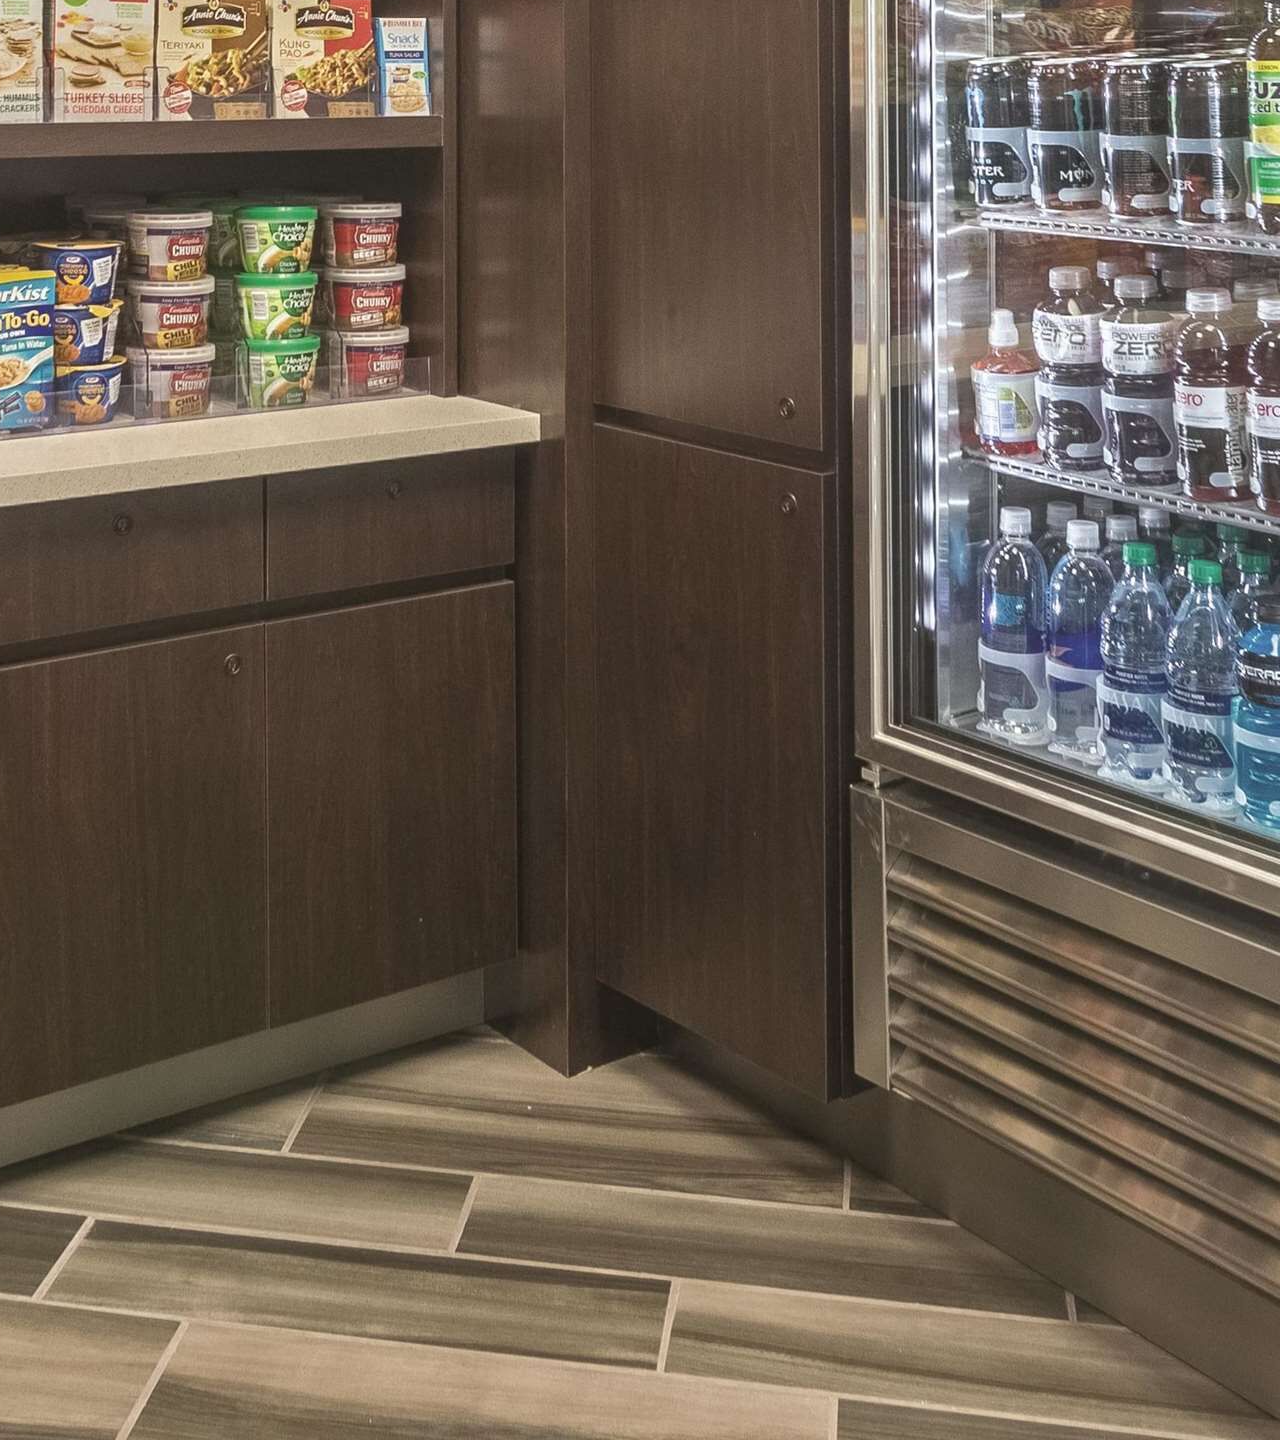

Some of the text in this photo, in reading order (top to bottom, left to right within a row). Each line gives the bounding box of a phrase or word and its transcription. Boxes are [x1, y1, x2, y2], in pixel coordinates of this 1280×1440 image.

[184, 8, 214, 24] Annie
[298, 9, 326, 24] Annie
[387, 33, 420, 44] Snack
[161, 40, 205, 50] TERIYAKI
[279, 40, 310, 48] KUNG
[279, 49, 300, 57] PAO
[4, 93, 40, 103] HUMMUS
[64, 93, 144, 103] TURKEY SLICES
[0, 104, 40, 113] CRACKERS
[72, 105, 144, 114] CHEDDAR CHEESE
[272, 232, 305, 243] Choice
[359, 233, 391, 245] CHUNKY
[172, 244, 204, 256] CHUNKY
[173, 261, 200, 273] CHILI
[356, 297, 391, 308] CHUNKY
[163, 314, 199, 325] CHUNKY
[163, 330, 191, 340] CHILI
[26, 339, 46, 348] Water
